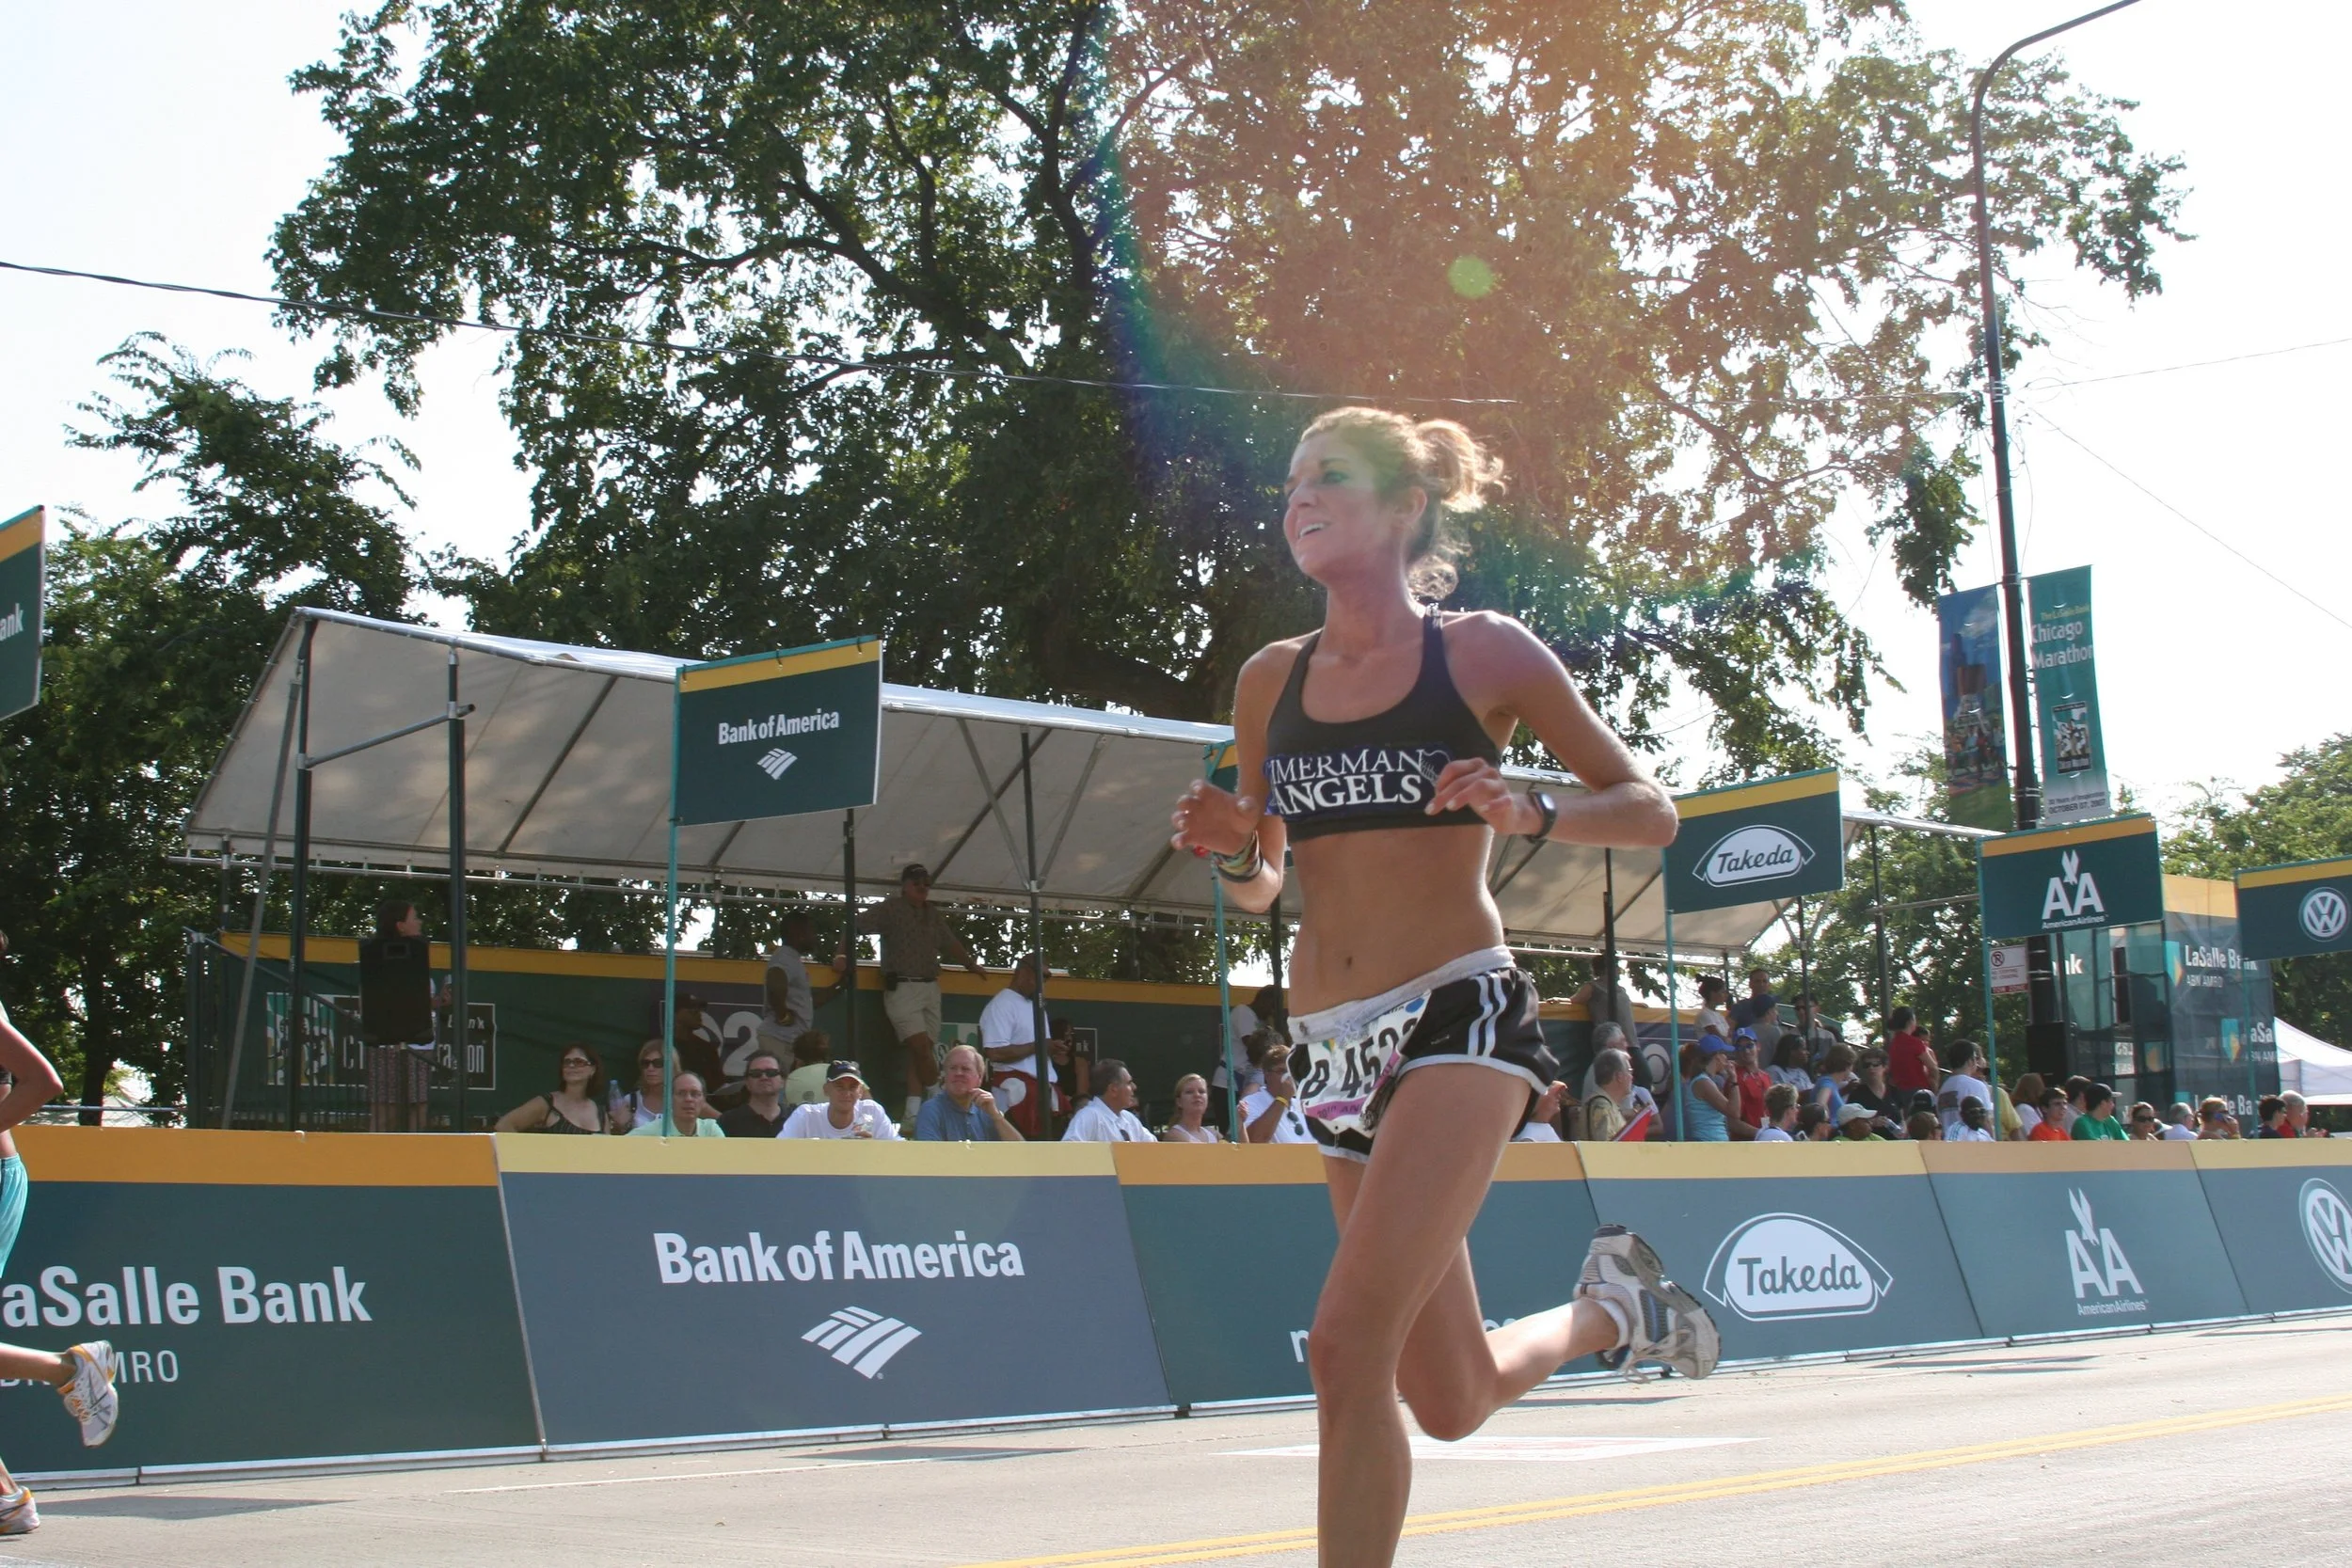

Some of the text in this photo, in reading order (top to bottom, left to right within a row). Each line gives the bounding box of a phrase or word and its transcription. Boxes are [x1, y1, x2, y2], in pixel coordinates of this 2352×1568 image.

[718, 708, 839, 745] Bank of America
[1717, 844, 1794, 875] Takeda
[2042, 872, 2106, 920] AA
[2185, 944, 2227, 969] LaSalle
[653, 1229, 1025, 1285] Bank of America
[1737, 1253, 1864, 1297] Takeda
[2065, 1227, 2145, 1299] AA
[2, 1265, 373, 1328] aSalle Bank
[112, 1349, 180, 1384] MRO
